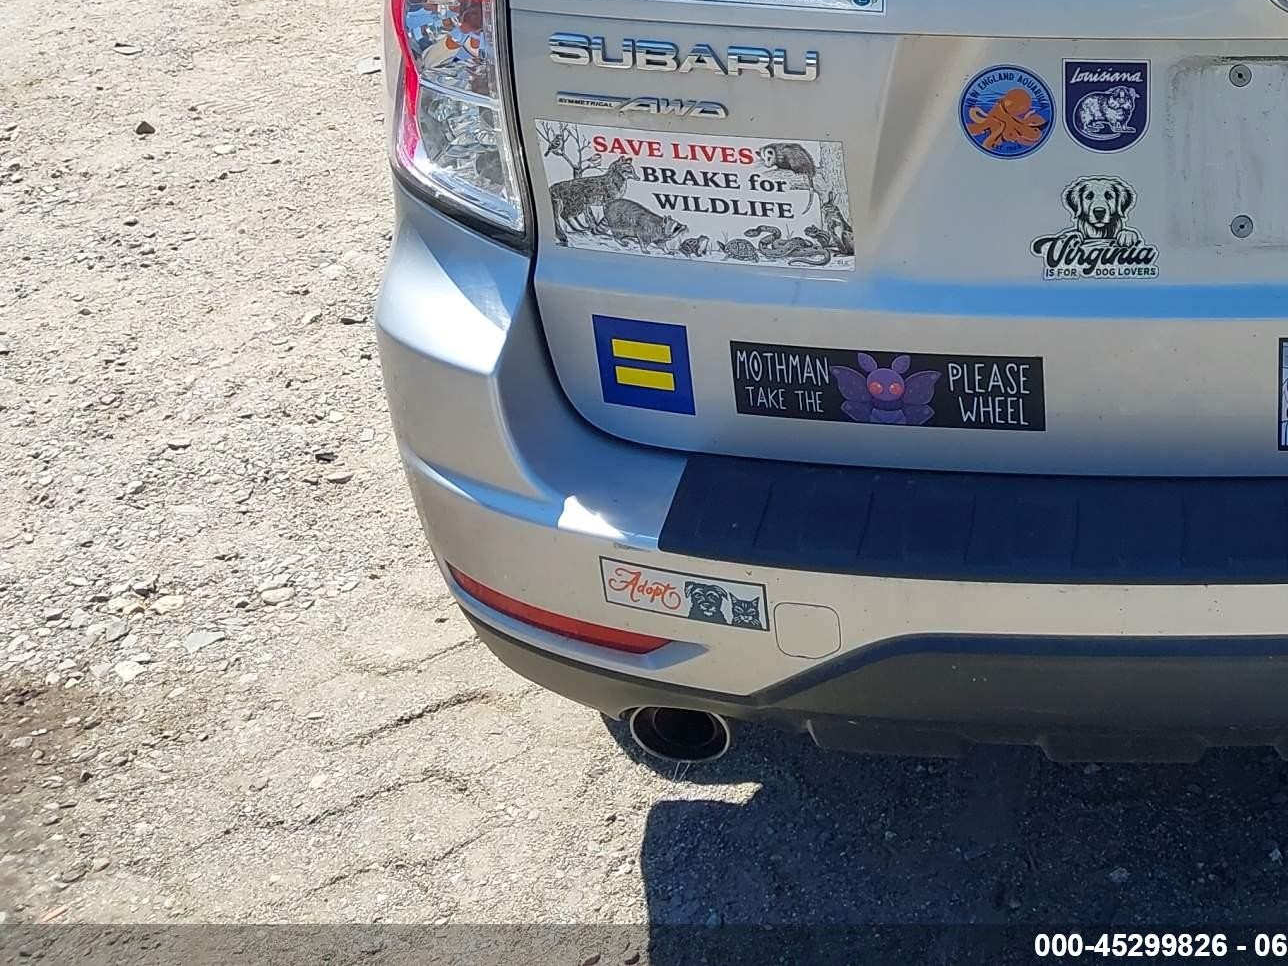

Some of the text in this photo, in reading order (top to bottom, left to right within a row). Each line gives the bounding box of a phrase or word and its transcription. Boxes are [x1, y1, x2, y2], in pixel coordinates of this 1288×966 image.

[549, 32, 820, 82] SUBARU
[977, 72, 1015, 91] ENGLAND
[1069, 66, 1144, 84] Louisiana
[558, 96, 729, 120] SYMMETRICAL AWD
[592, 135, 755, 165] SAVE LIVES
[639, 165, 788, 193] BRAKE for
[653, 191, 795, 219] WILDLIFE
[1033, 234, 1156, 275] Virginia
[1045, 267, 1156, 277] IS FOR DOG LOVERS
[736, 349, 1031, 395] MOTHMAN PLEASE
[744, 385, 1030, 426] TAKE THE WHEEL
[608, 567, 682, 610] Adopt
